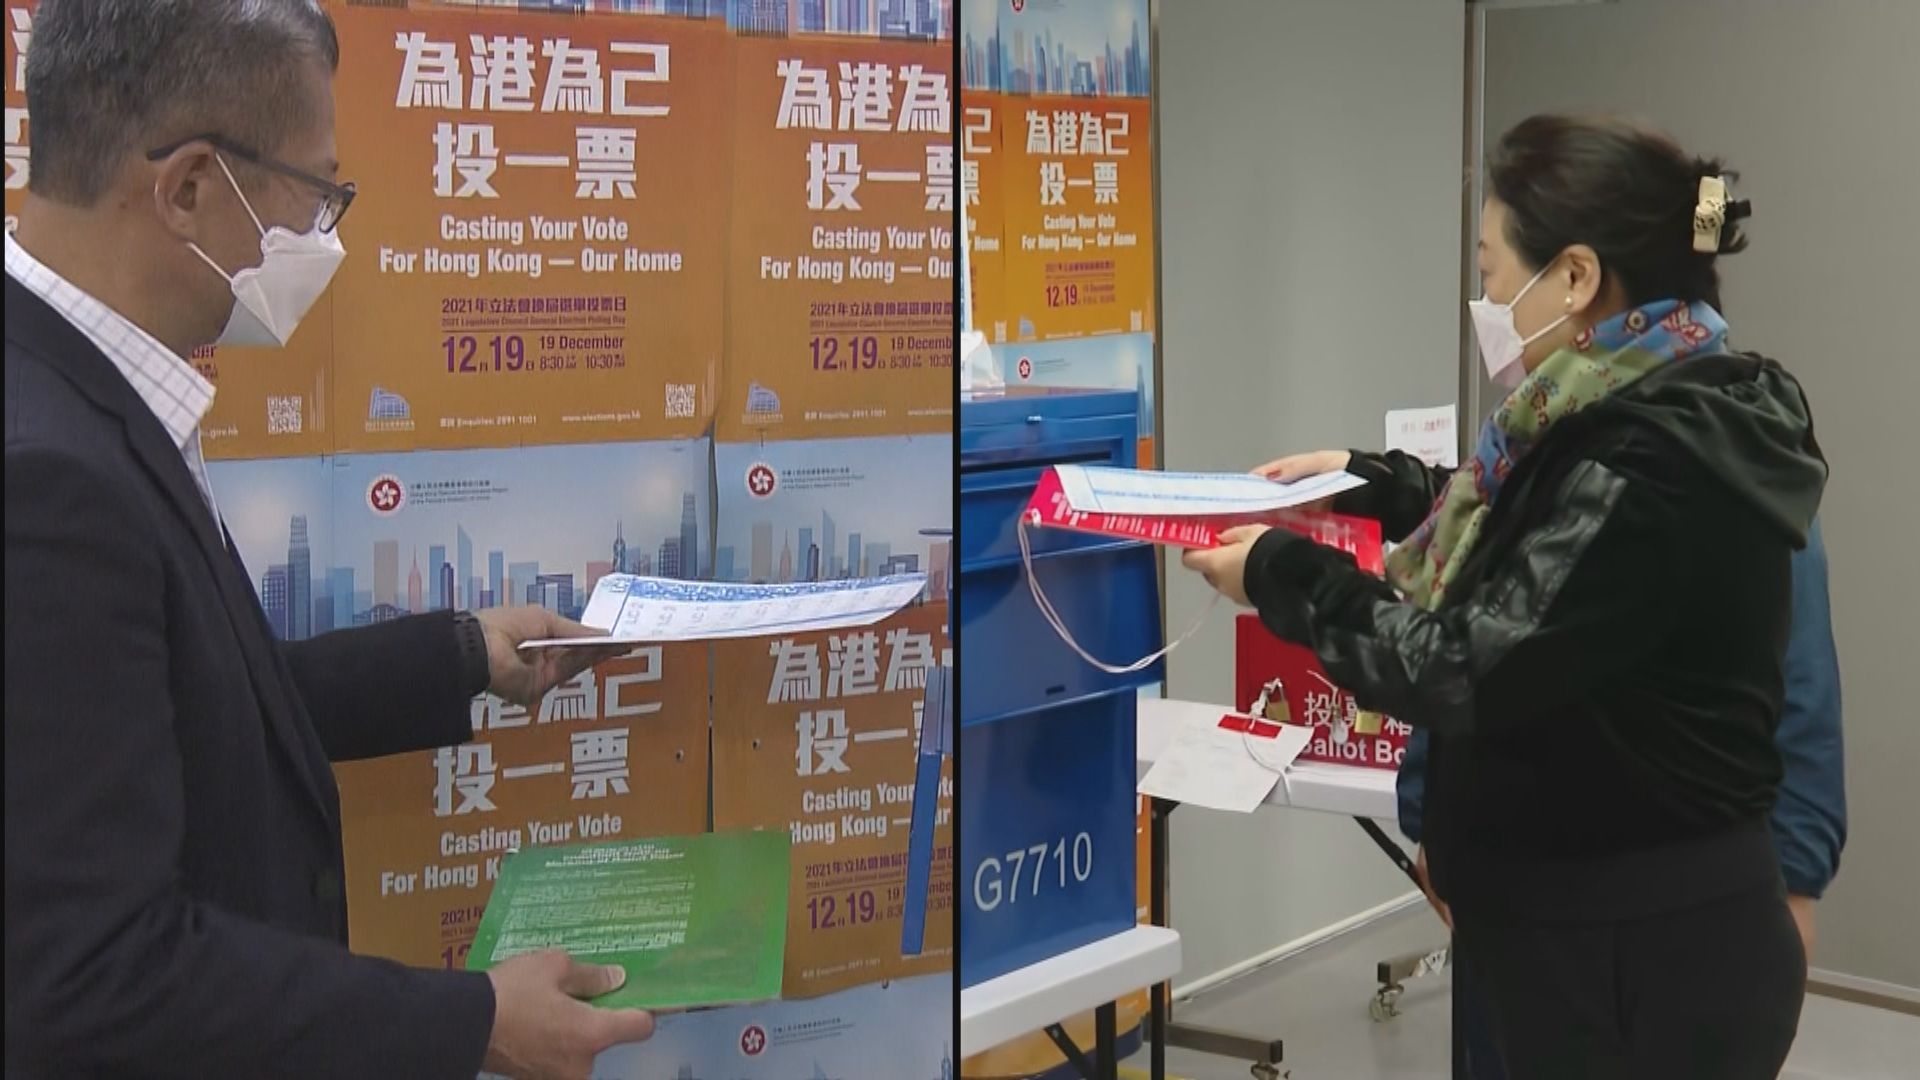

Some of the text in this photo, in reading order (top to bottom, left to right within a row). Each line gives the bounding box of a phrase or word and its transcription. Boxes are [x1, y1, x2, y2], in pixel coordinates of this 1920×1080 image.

[395, 32, 671, 116] 為港為己
[1026, 110, 1130, 156] 為港為己
[432, 121, 638, 199] 投一票
[1039, 161, 1120, 206] 投一票
[440, 215, 629, 245] Casting Your Vote
[1043, 214, 1076, 232] Casting
[1078, 213, 1096, 229] Your
[812, 226, 881, 254] Casting
[886, 226, 926, 250] Your
[1021, 235, 1037, 250] For
[1038, 234, 1060, 252] Hong
[1061, 233, 1084, 251] Kong
[1096, 232, 1112, 247] Our
[1113, 231, 1137, 246] Home
[380, 248, 418, 273] For
[424, 247, 480, 278] Hong
[487, 247, 543, 278] Kong
[581, 247, 619, 273] Our
[624, 247, 682, 272] Home
[760, 256, 791, 280] For
[797, 256, 843, 284] Hong
[849, 256, 895, 284] Kong
[540, 334, 624, 350] 19 December
[891, 336, 905, 351] 19
[540, 355, 564, 370] 8:30
[586, 353, 613, 369] 10:30
[433, 727, 631, 817] 投一票
[802, 784, 872, 813] Casting
[440, 814, 623, 856] Casting Your Vote
[790, 820, 836, 845] Hong
[841, 813, 888, 837] Kong
[381, 870, 418, 896] For
[424, 862, 479, 889] Hong
[974, 831, 1093, 912] G7710
